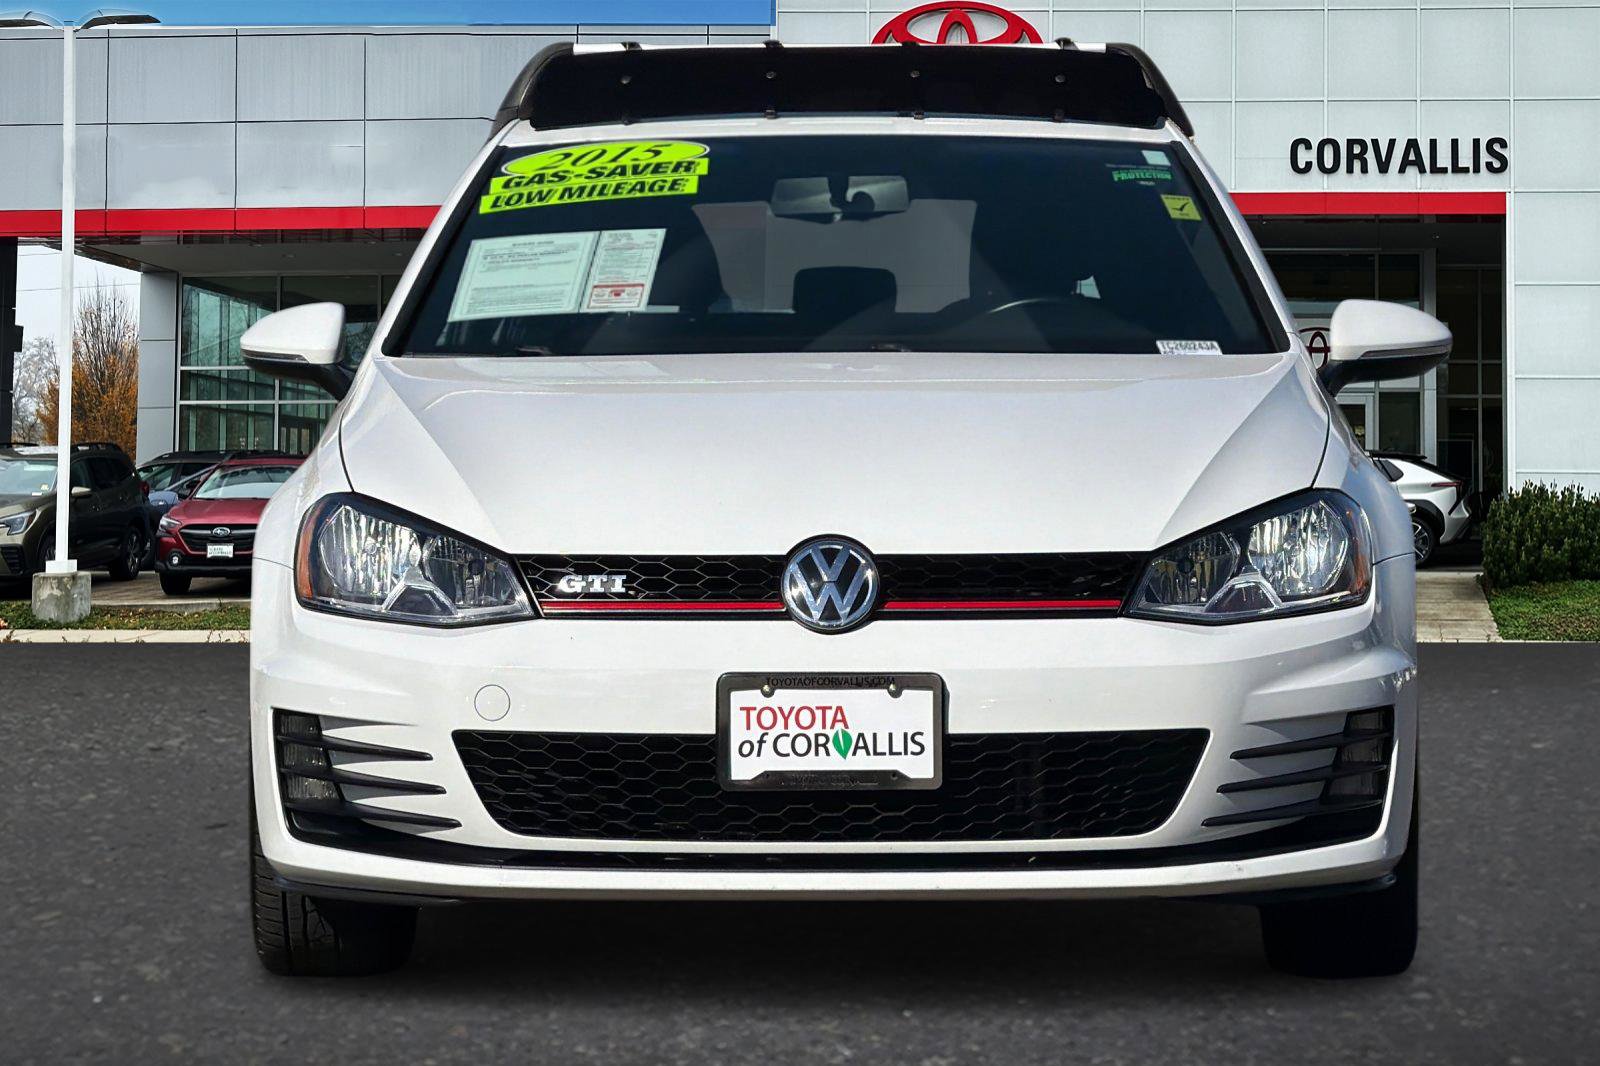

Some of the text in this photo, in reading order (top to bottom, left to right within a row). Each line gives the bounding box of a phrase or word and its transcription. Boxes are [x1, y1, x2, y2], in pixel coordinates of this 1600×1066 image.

[536, 143, 672, 171] 2015
[1289, 137, 1509, 175] CORVALLIS
[501, 159, 700, 190] GAS-SAVER
[489, 177, 690, 210] LOW MILEAGE
[556, 574, 627, 593] GTI
[766, 676, 896, 688] TOYOTAOFCORVALLIS.COM
[739, 705, 850, 731] TOYOTA
[738, 729, 926, 760] of CORVALLIS
